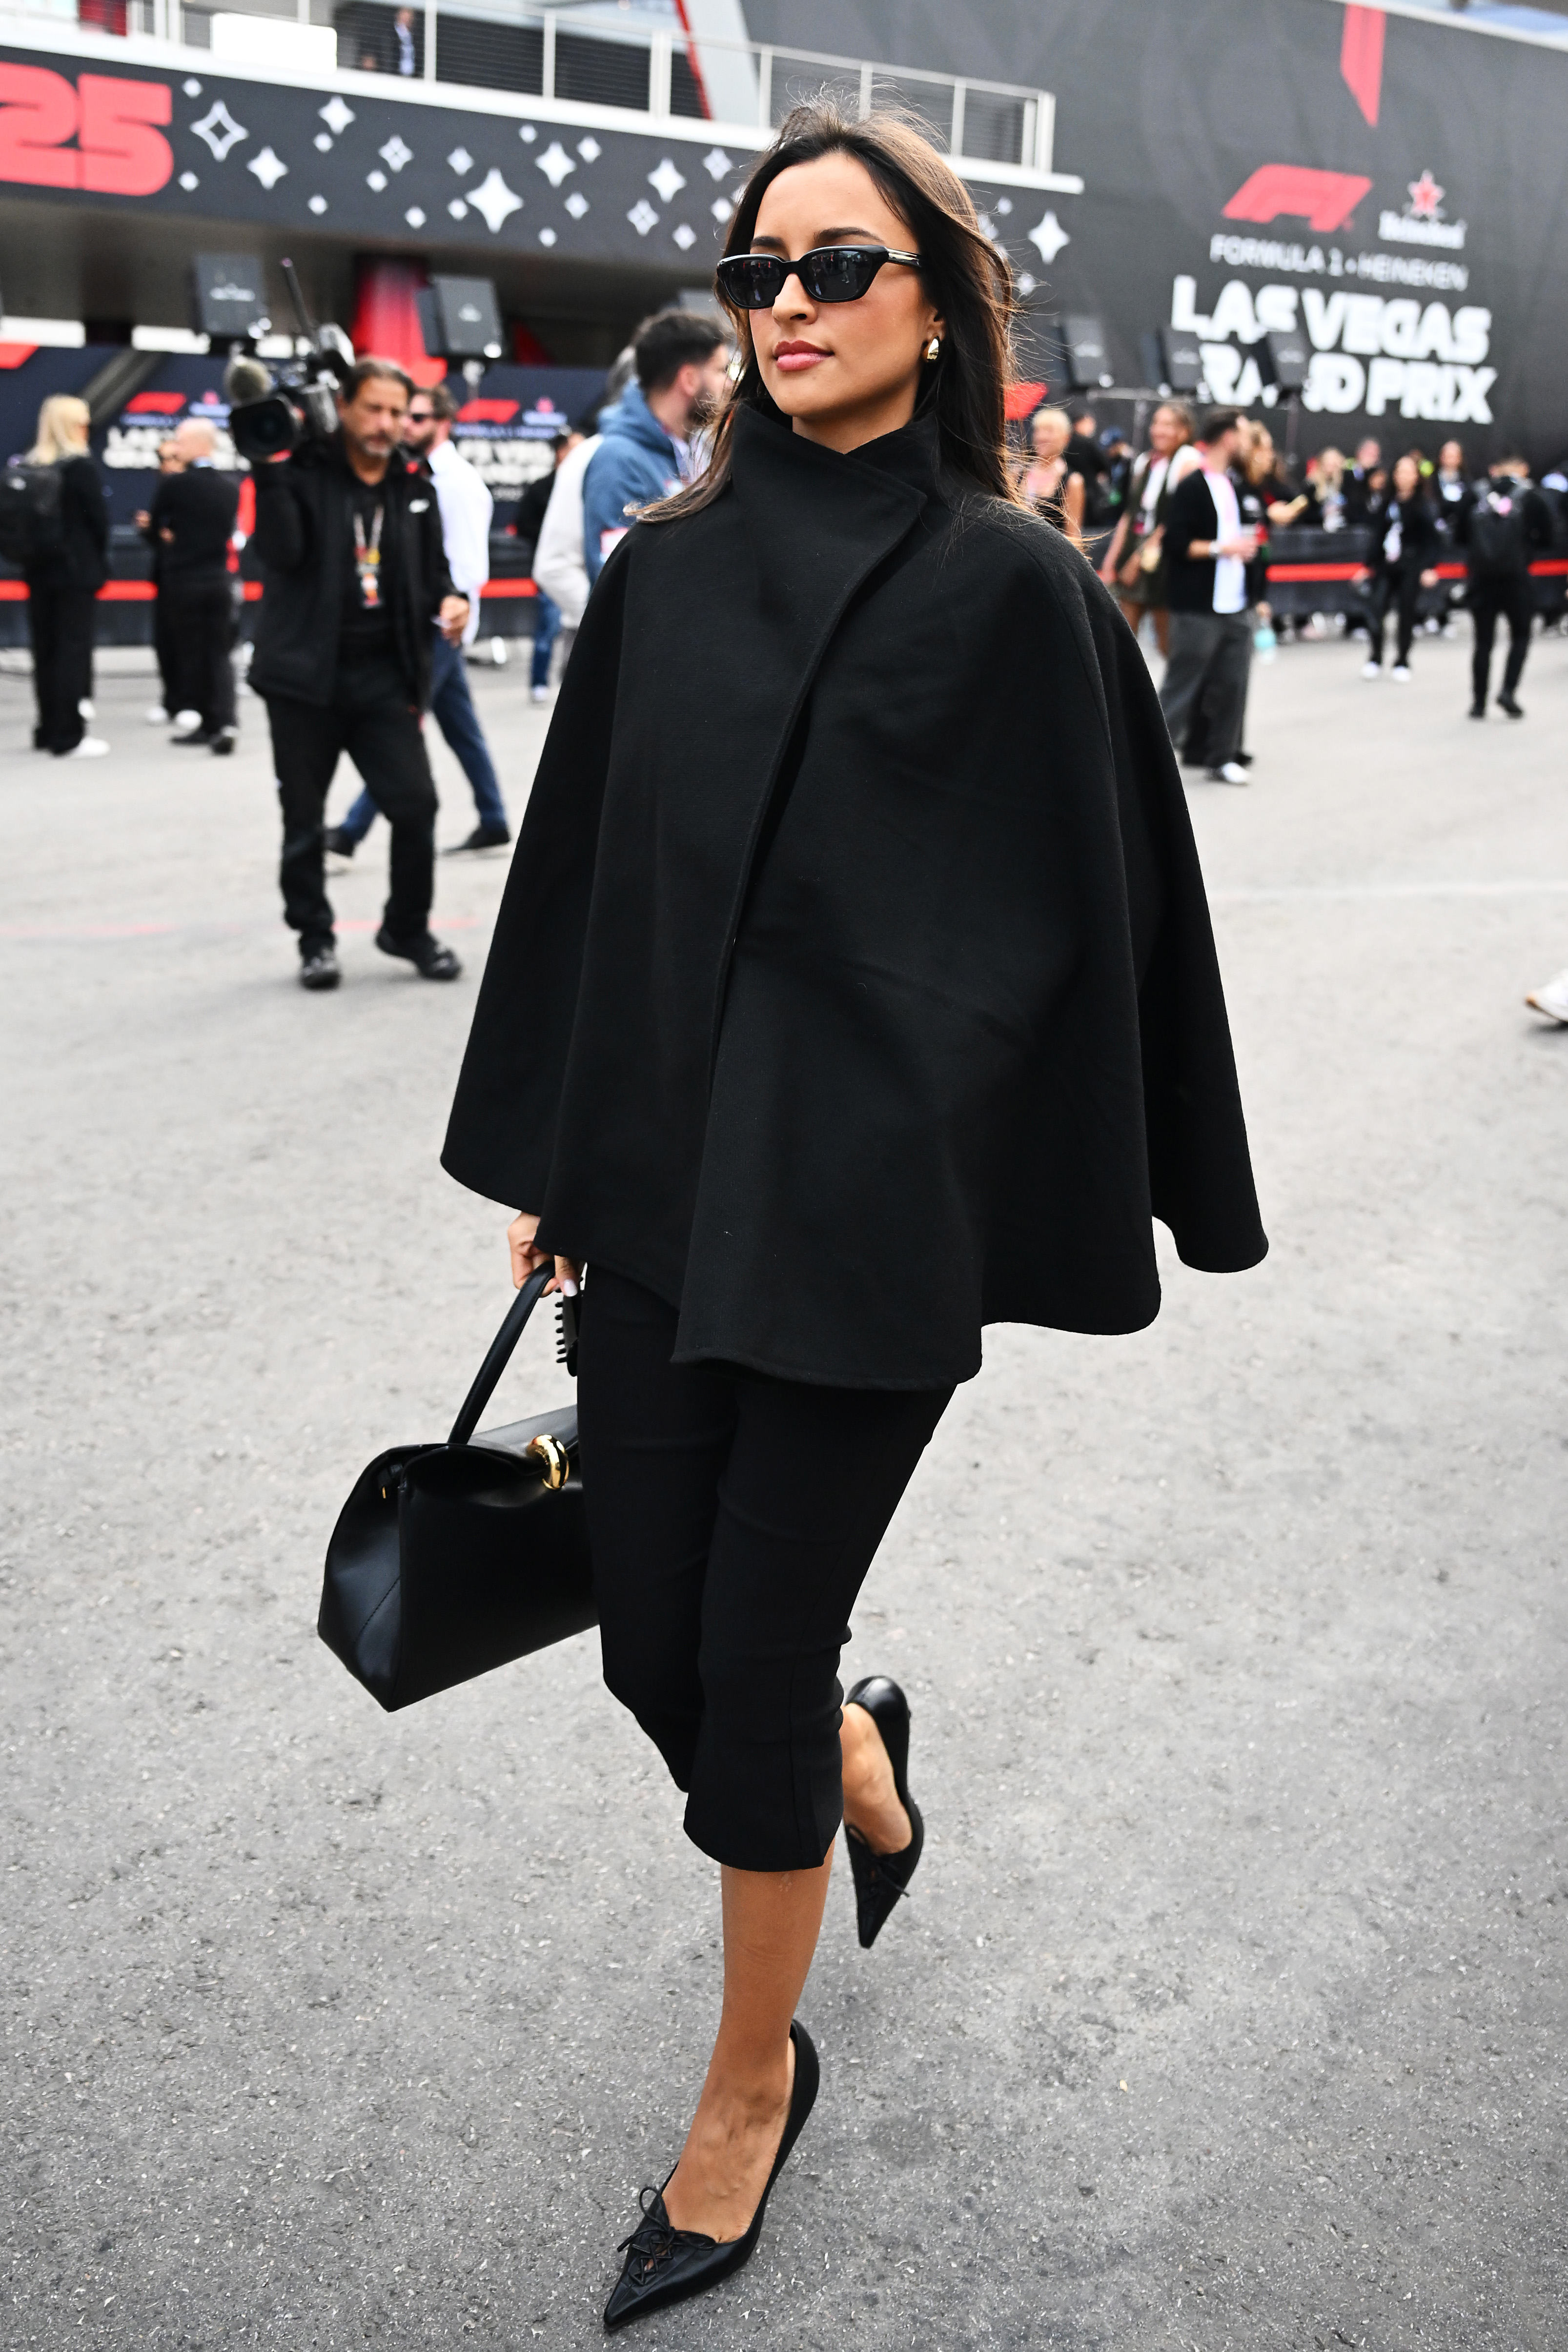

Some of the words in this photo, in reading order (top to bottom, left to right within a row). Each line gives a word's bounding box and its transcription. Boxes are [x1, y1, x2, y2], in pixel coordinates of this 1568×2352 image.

[1210, 233, 1325, 274] FORMULA
[1328, 246, 1344, 277] 1
[1357, 251, 1469, 292] HEINEKEN
[1171, 274, 1299, 344] LAS
[1302, 287, 1491, 365] VEGAS
[1366, 356, 1498, 425] PRIX
